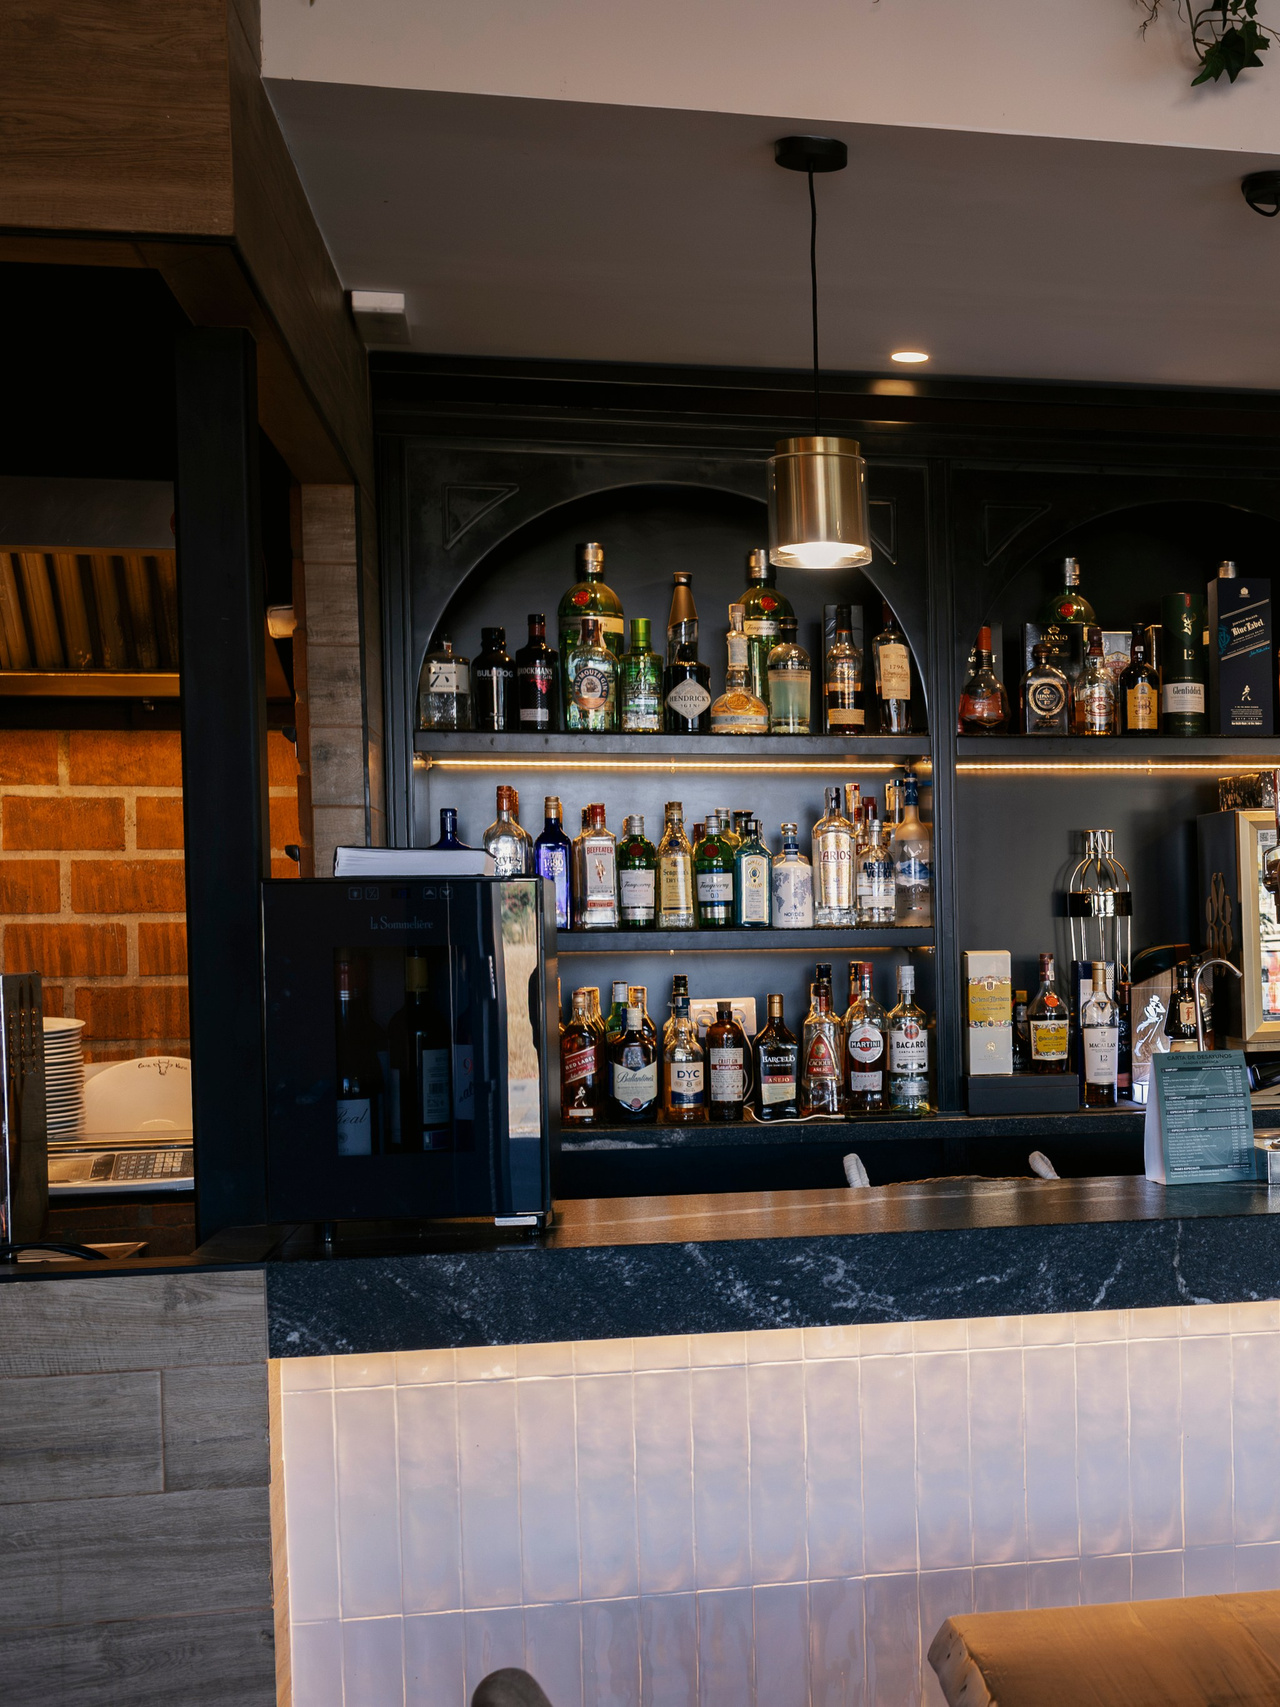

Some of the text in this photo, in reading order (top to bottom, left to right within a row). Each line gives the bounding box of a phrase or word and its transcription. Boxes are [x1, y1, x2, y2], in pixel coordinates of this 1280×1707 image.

[1231, 619, 1264, 636] Blue Label
[1183, 648, 1195, 660] 12
[477, 668, 514, 678] BULLDOG
[575, 669, 603, 690] PLYMOUTH
[586, 846, 614, 855] BEEFEATER
[863, 862, 894, 870] ABSOLUT
[867, 870, 892, 878] VODKA
[370, 916, 434, 930] la Sommelière
[896, 1039, 927, 1049] BACARDÍ
[577, 1055, 595, 1066] LABEL
[762, 1054, 796, 1063] BARCELÓ
[617, 1072, 654, 1083] Ballantine's
[677, 1070, 700, 1078] DYC
